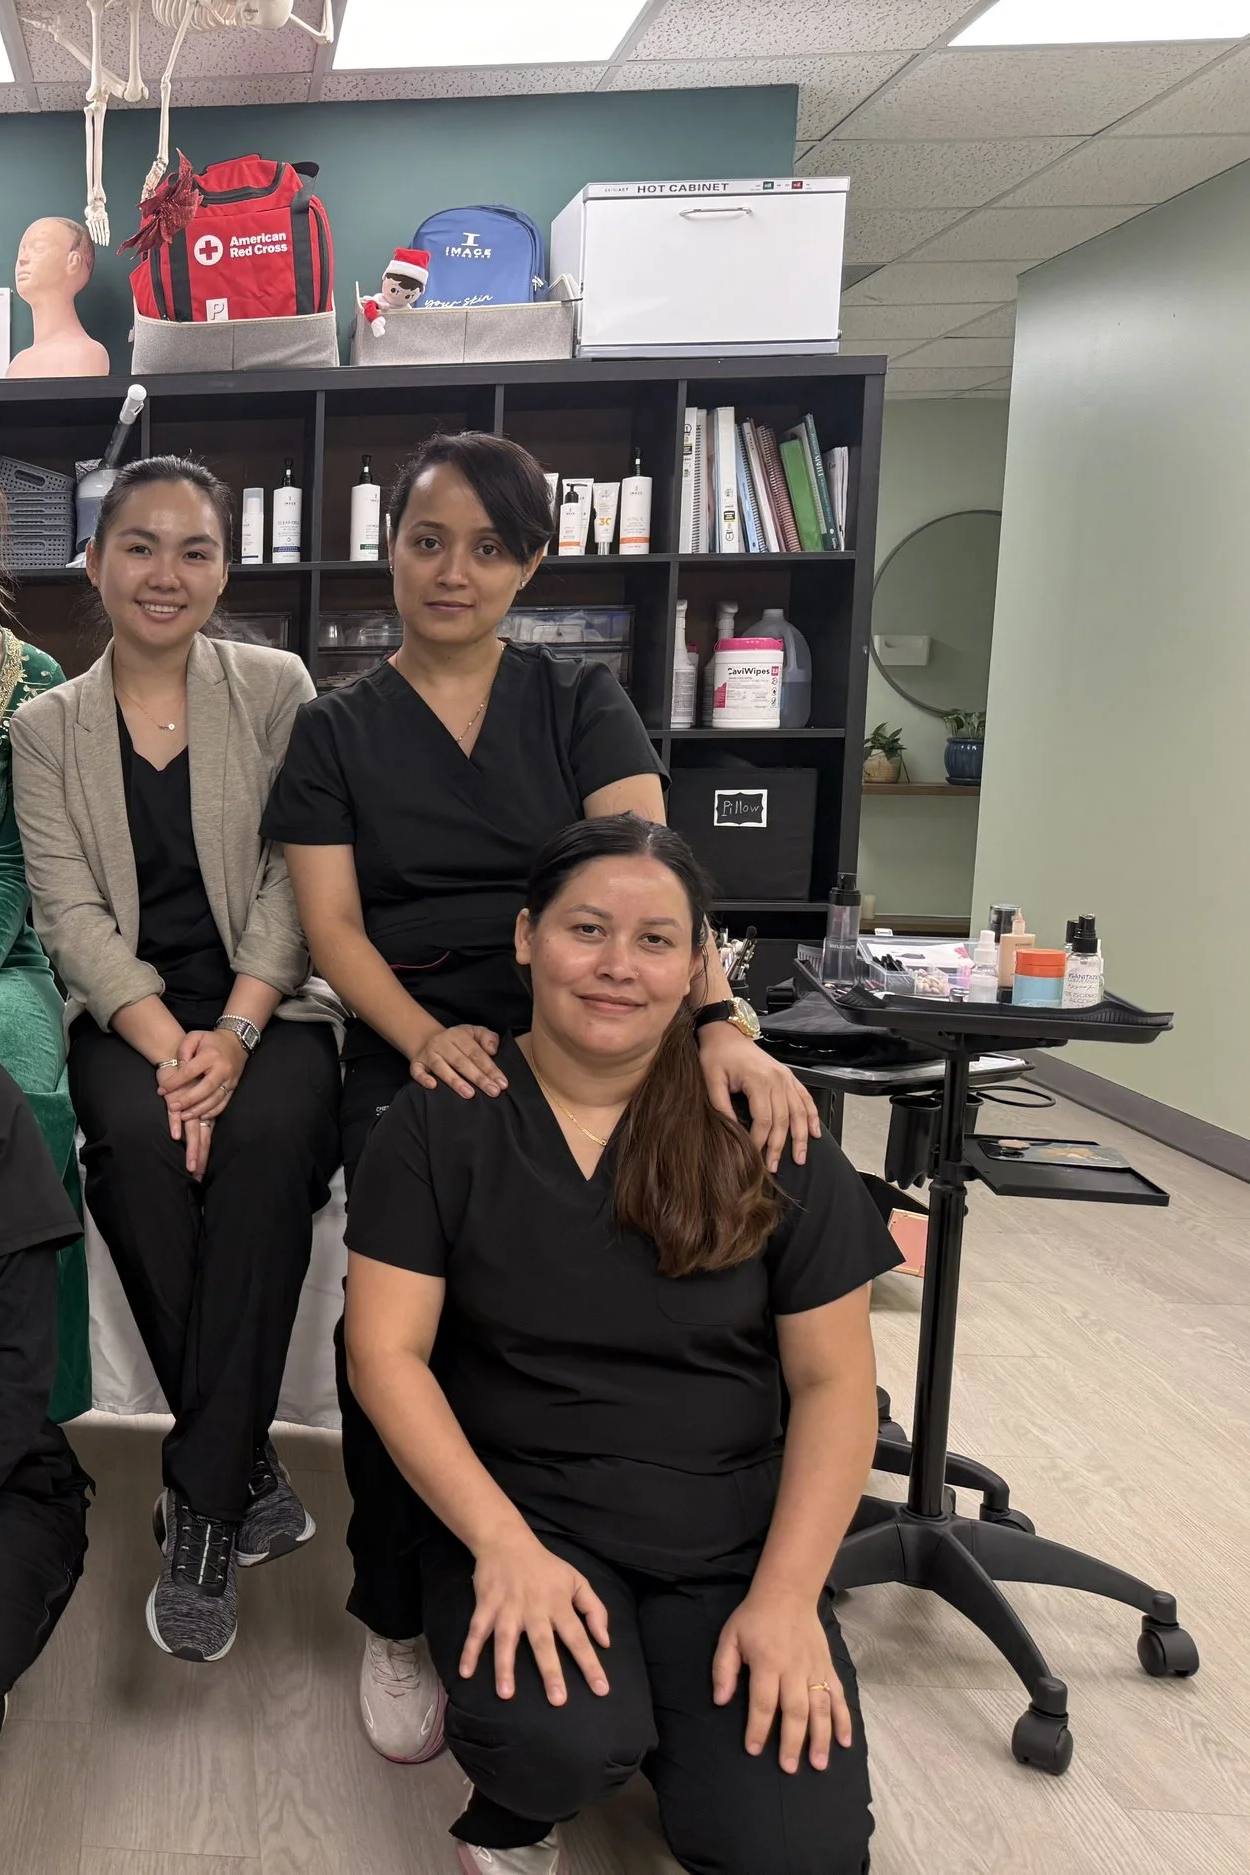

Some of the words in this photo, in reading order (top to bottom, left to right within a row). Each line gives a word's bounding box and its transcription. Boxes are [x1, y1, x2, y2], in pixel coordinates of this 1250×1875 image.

[637, 184, 666, 194] HOT
[669, 183, 730, 193] CABINET
[230, 232, 287, 247] American
[230, 246, 253, 258] Red
[254, 243, 288, 255] Cross
[445, 246, 492, 258] IMAGE
[727, 667, 770, 676] CaviWipes
[721, 800, 760, 817] Pillow
